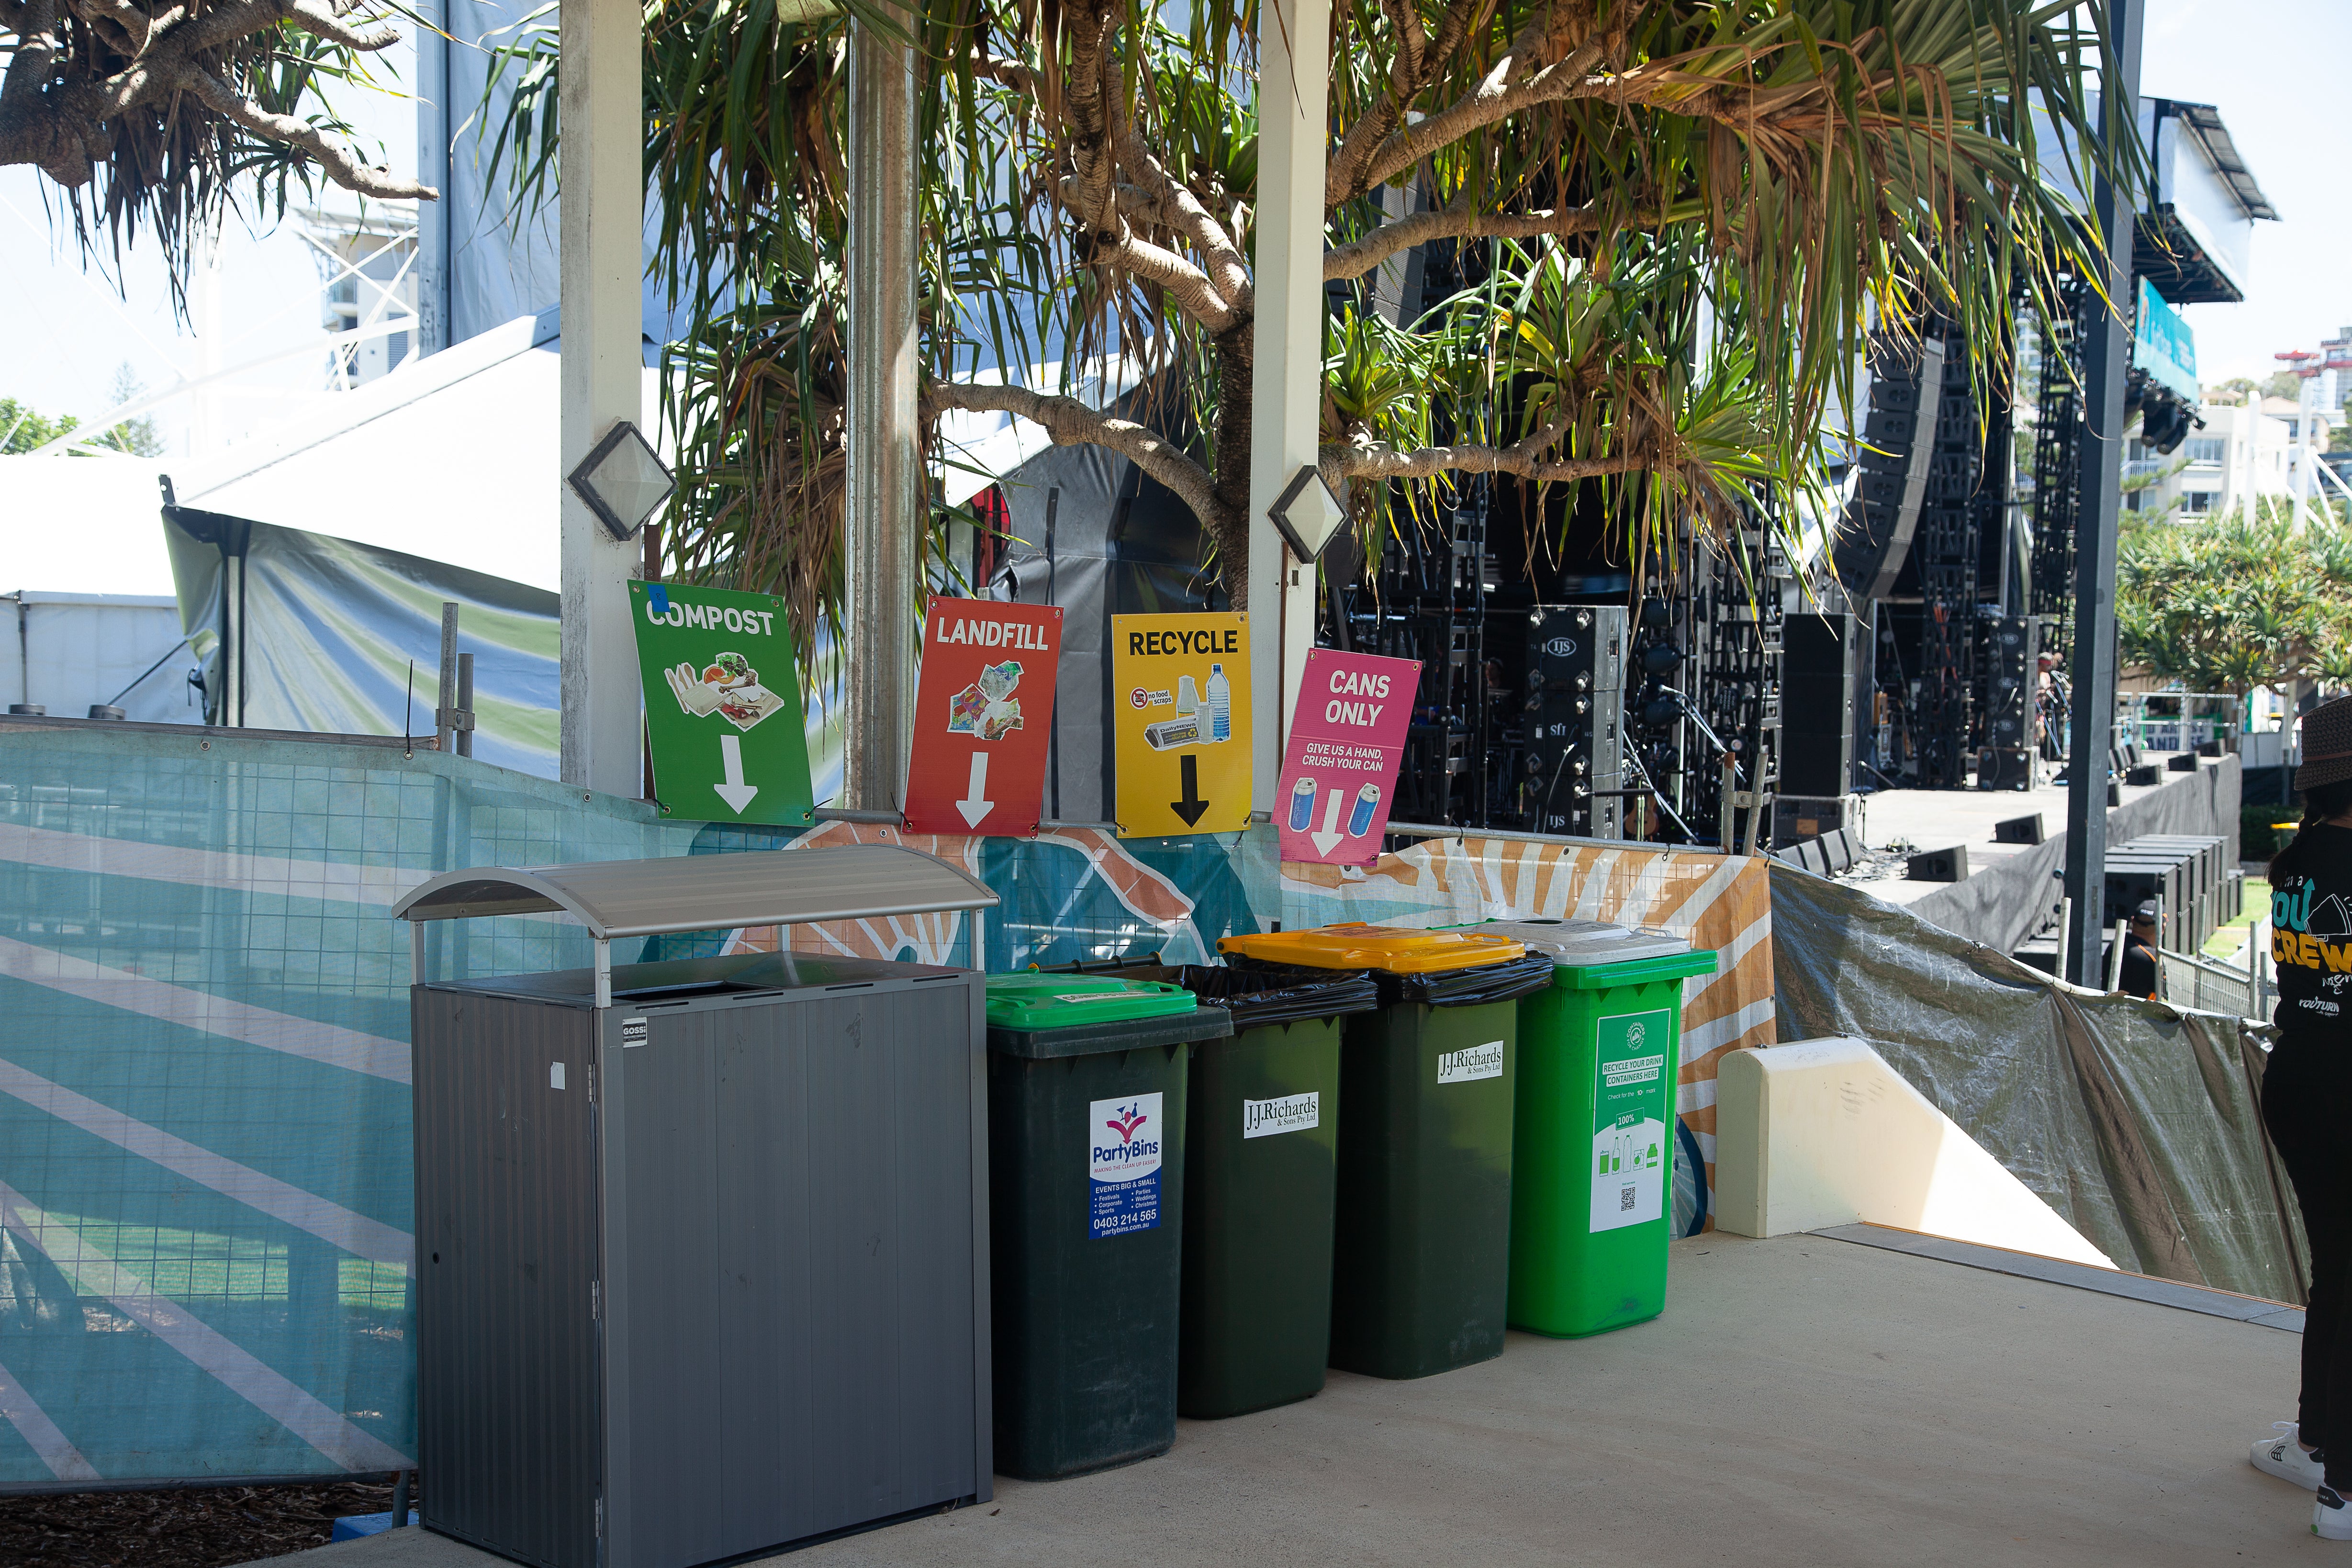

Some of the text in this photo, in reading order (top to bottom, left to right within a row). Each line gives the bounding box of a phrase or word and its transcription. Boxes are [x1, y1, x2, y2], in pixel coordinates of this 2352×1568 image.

[646, 600, 773, 636] COMPOST
[937, 617, 1048, 650] LANDFILL
[1129, 630, 1238, 656] RECYCLE
[1554, 641, 1570, 654] IJS
[1329, 670, 1391, 699] CANS
[1325, 700, 1384, 727] ONLY
[1160, 723, 1196, 732] DailyNEWS
[1307, 742, 1383, 761] GIVE US A HAND,
[1302, 755, 1383, 772] CRUSH YOUR CAN
[1549, 815, 1565, 829] IJS
[2272, 927, 2352, 974] CREW
[1626, 1021, 1646, 1038] CONTAINERS
[1631, 1037, 1645, 1051] CHANGE
[1603, 1056, 1662, 1072] RECYCLE YOUR DRINK
[1607, 1070, 1658, 1084] CONTAINERS HERE
[1297, 1115, 1306, 1124] Pty
[1307, 1113, 1315, 1121] Ltd
[1618, 1114, 1635, 1126] 100%
[1093, 1139, 1158, 1164] PartyBins
[1096, 1184, 1120, 1194] EVENTS
[1138, 1178, 1156, 1187] SMALL
[1099, 1200, 1122, 1208] Corporate
[1135, 1200, 1157, 1209] Christmas
[1094, 1209, 1156, 1230] 0403 214 565
[1102, 1222, 1149, 1237] partybins.com.au
